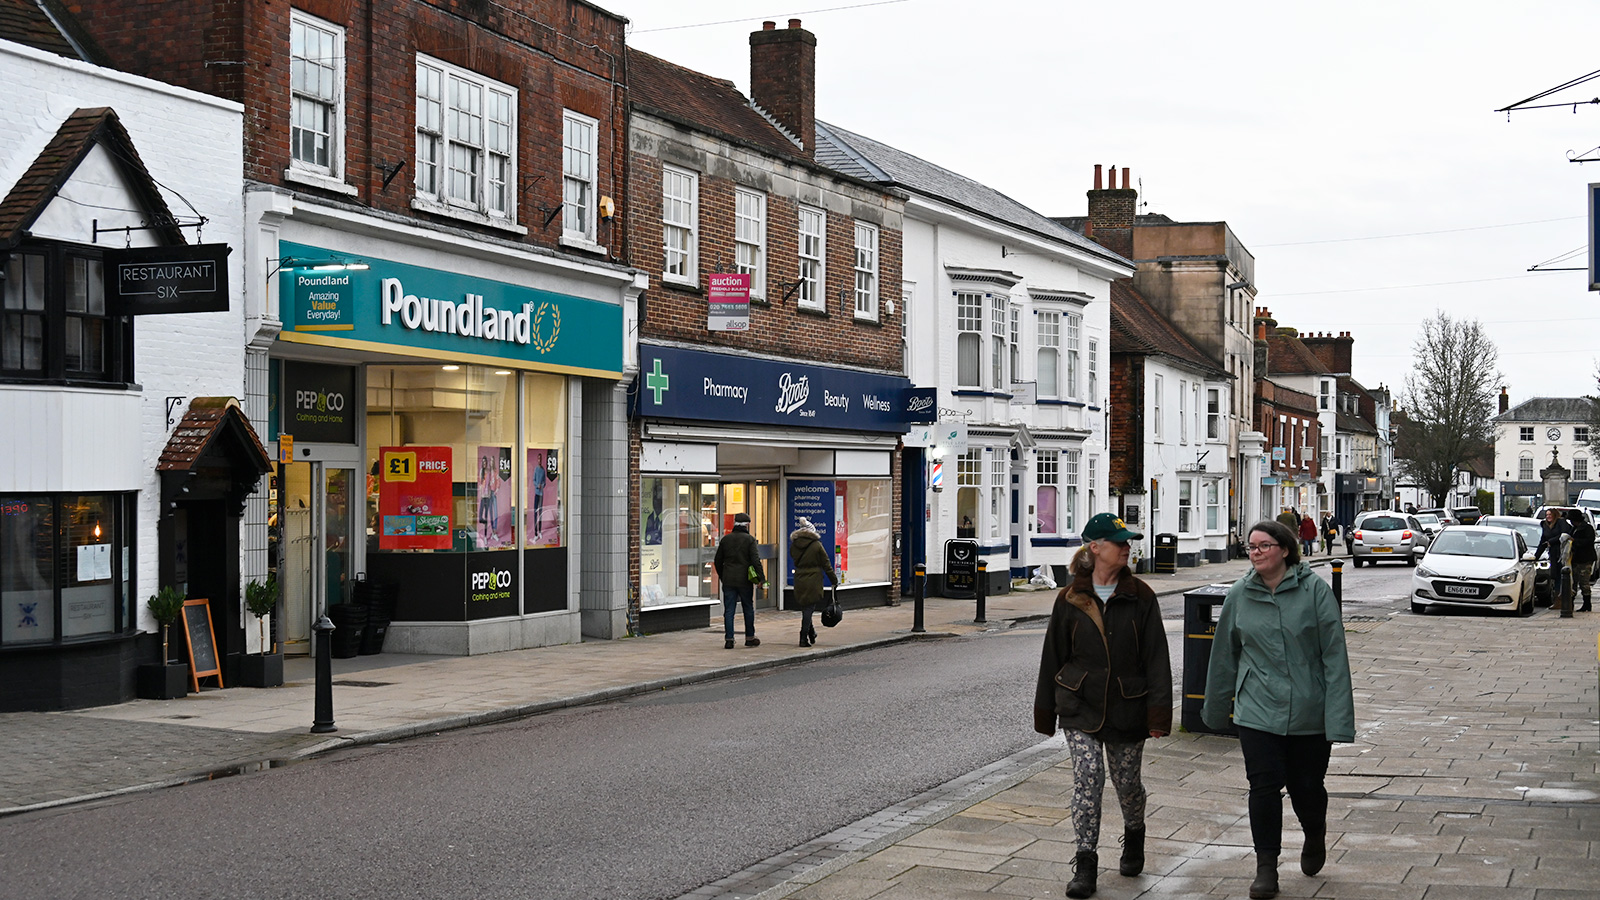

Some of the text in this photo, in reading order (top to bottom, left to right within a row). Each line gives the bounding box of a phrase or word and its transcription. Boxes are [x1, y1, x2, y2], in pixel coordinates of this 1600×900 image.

[123, 264, 212, 281] RESTAURANT
[298, 275, 349, 286] Poundland
[711, 276, 742, 286] auction
[157, 286, 179, 299] SIX
[308, 291, 340, 302] Amazing
[311, 300, 337, 311] Value
[306, 310, 341, 321] Everyday!
[726, 320, 747, 329] allsop
[703, 372, 891, 415] Pharmacy Boots Beauty Wellness
[906, 396, 934, 412] Boots
[296, 412, 317, 424] Clothing
[389, 457, 447, 474] £1 PRICE
[500, 459, 511, 470] £14
[547, 457, 557, 471] £9
[794, 485, 830, 493] welcome
[471, 593, 490, 602] Clothing
